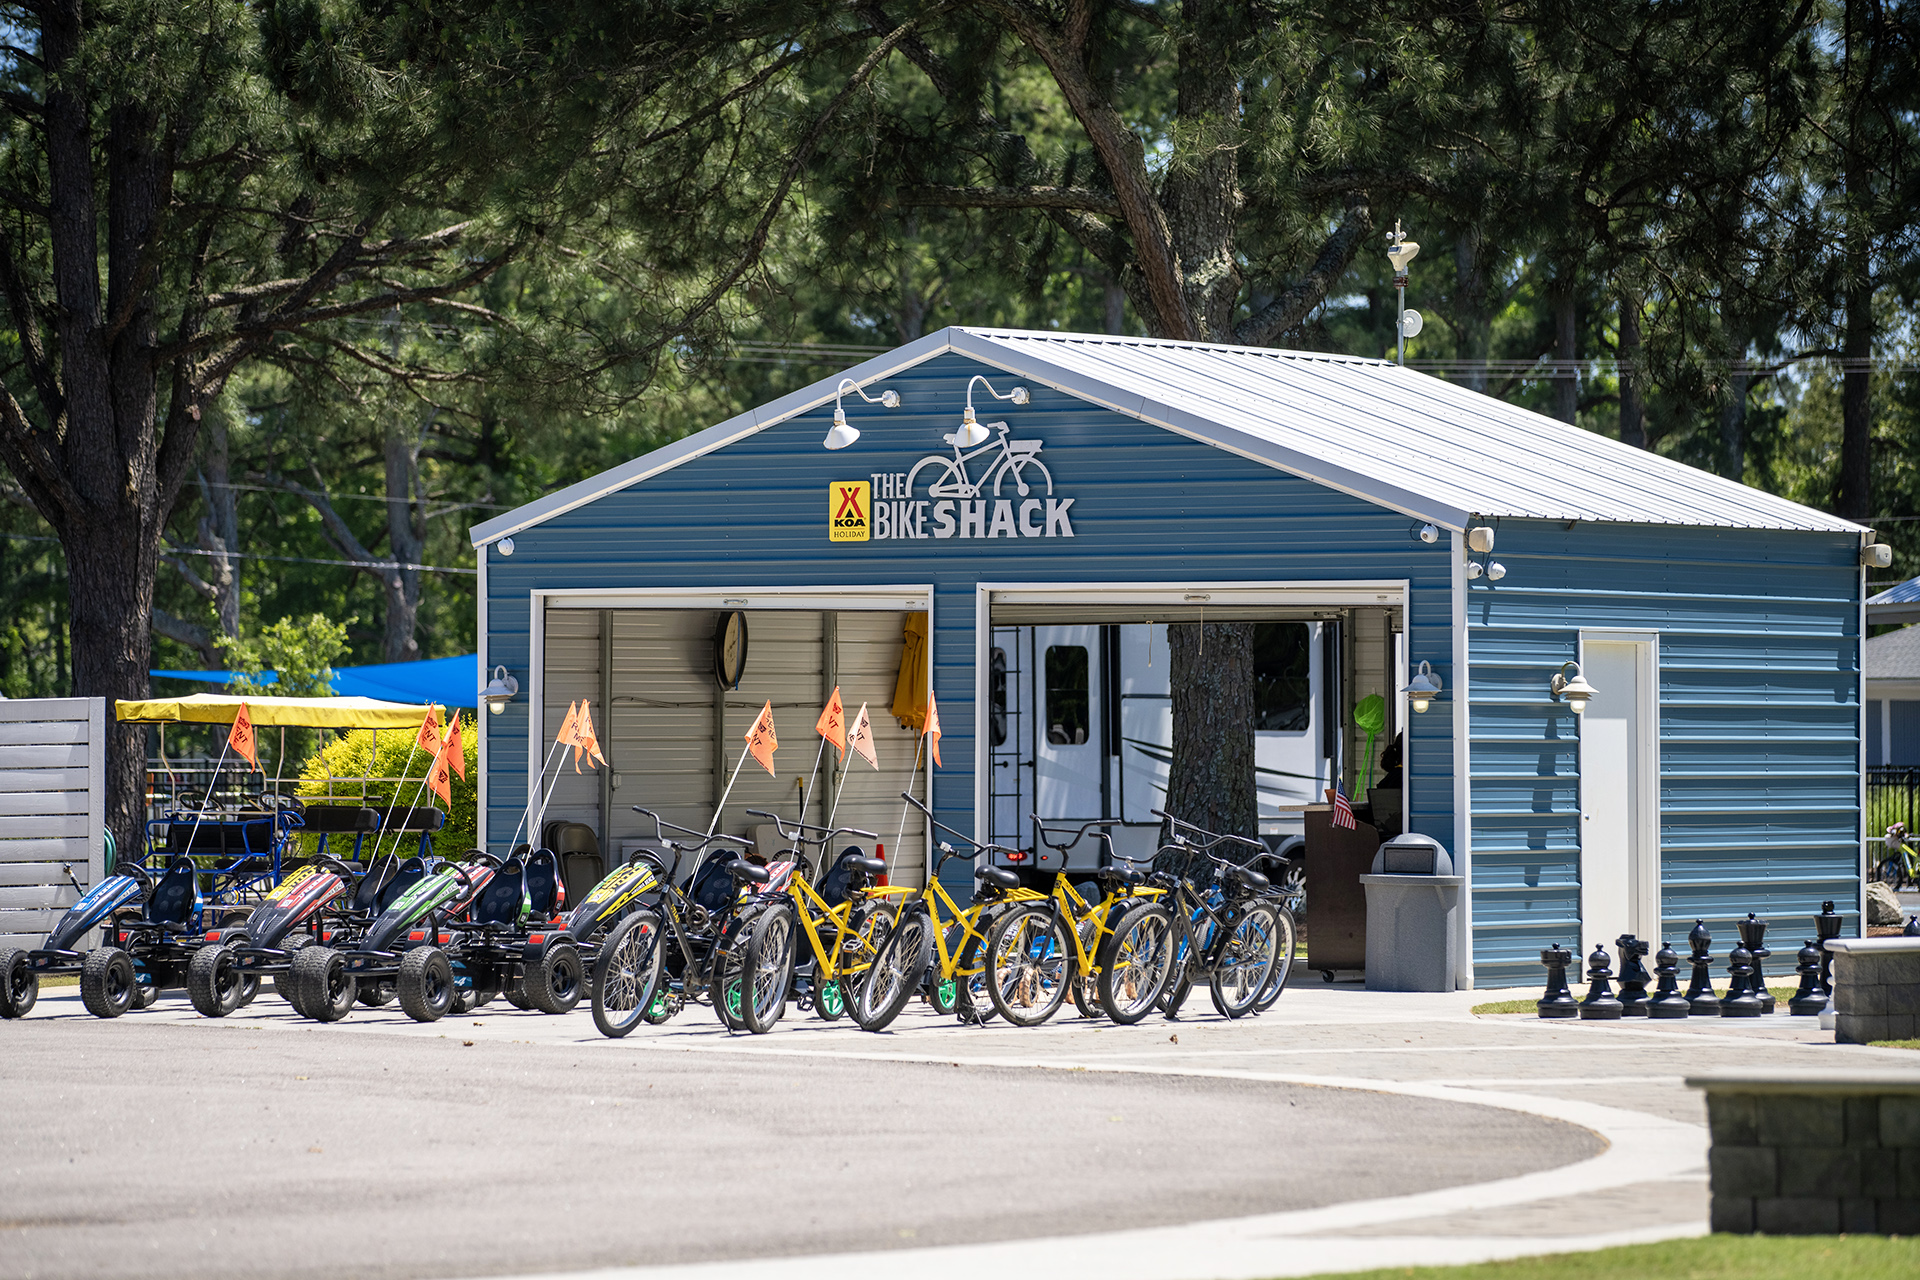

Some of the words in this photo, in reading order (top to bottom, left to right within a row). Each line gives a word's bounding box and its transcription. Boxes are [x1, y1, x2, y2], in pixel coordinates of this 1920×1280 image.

[871, 473, 907, 499] THE
[834, 518, 866, 528] KOA
[874, 500, 931, 539] BIKE
[932, 498, 1075, 538] SHACK
